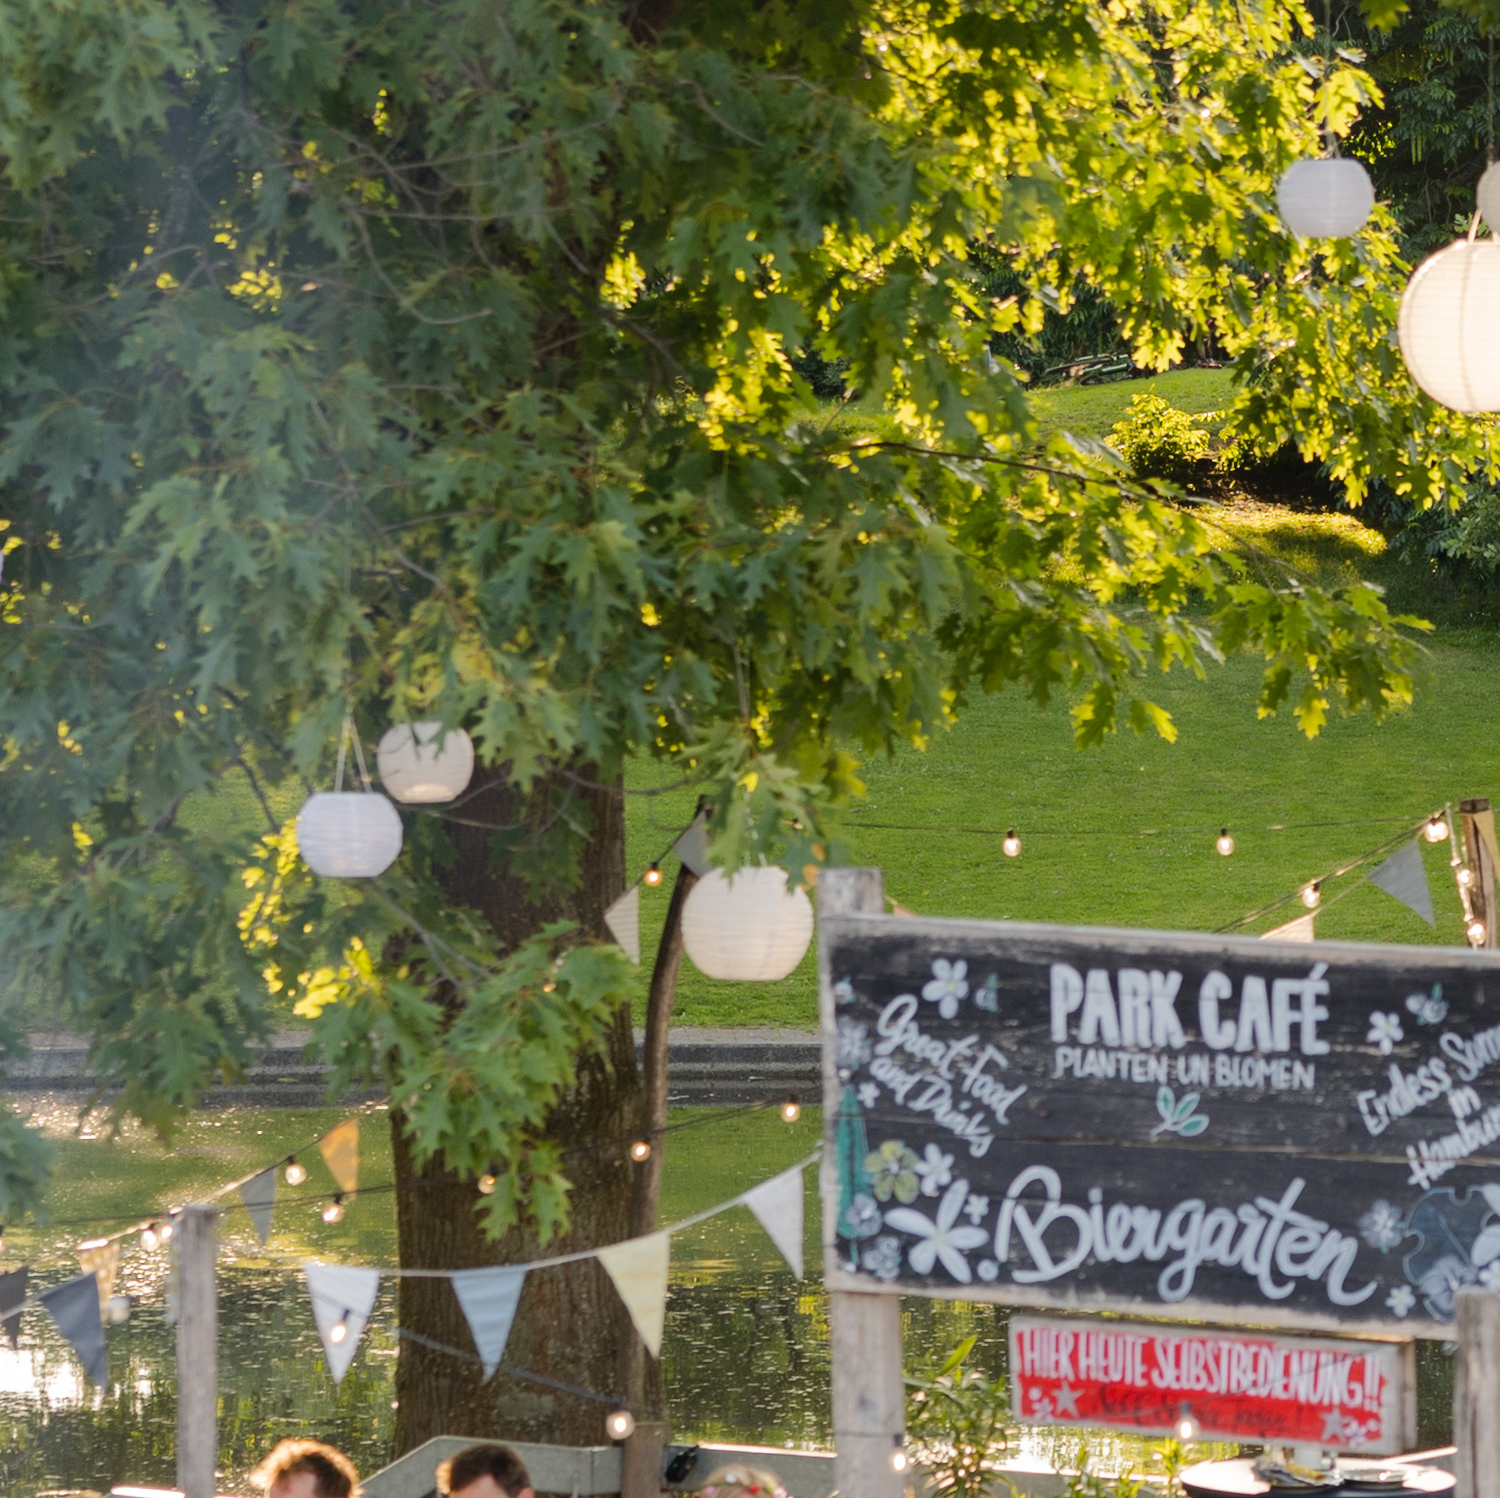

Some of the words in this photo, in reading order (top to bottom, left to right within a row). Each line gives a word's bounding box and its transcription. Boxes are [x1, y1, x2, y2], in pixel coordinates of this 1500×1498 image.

[1051, 963, 1187, 1049] PARK
[1199, 961, 1331, 1055] CAFÉ
[874, 994, 980, 1080] Great
[961, 1044, 1028, 1125] Food
[1053, 1046, 1169, 1087] PLANTEN
[1177, 1052, 1211, 1088] UN
[1214, 1053, 1316, 1090] BLOMEN
[1356, 1056, 1453, 1137] Endless
[1447, 1084, 1482, 1120] in
[869, 1056, 924, 1106] and
[906, 1074, 996, 1159] Drinks
[994, 1164, 1379, 1306] Biergarten
[1022, 1328, 1075, 1381] HIER
[1078, 1331, 1149, 1386] HEUTE
